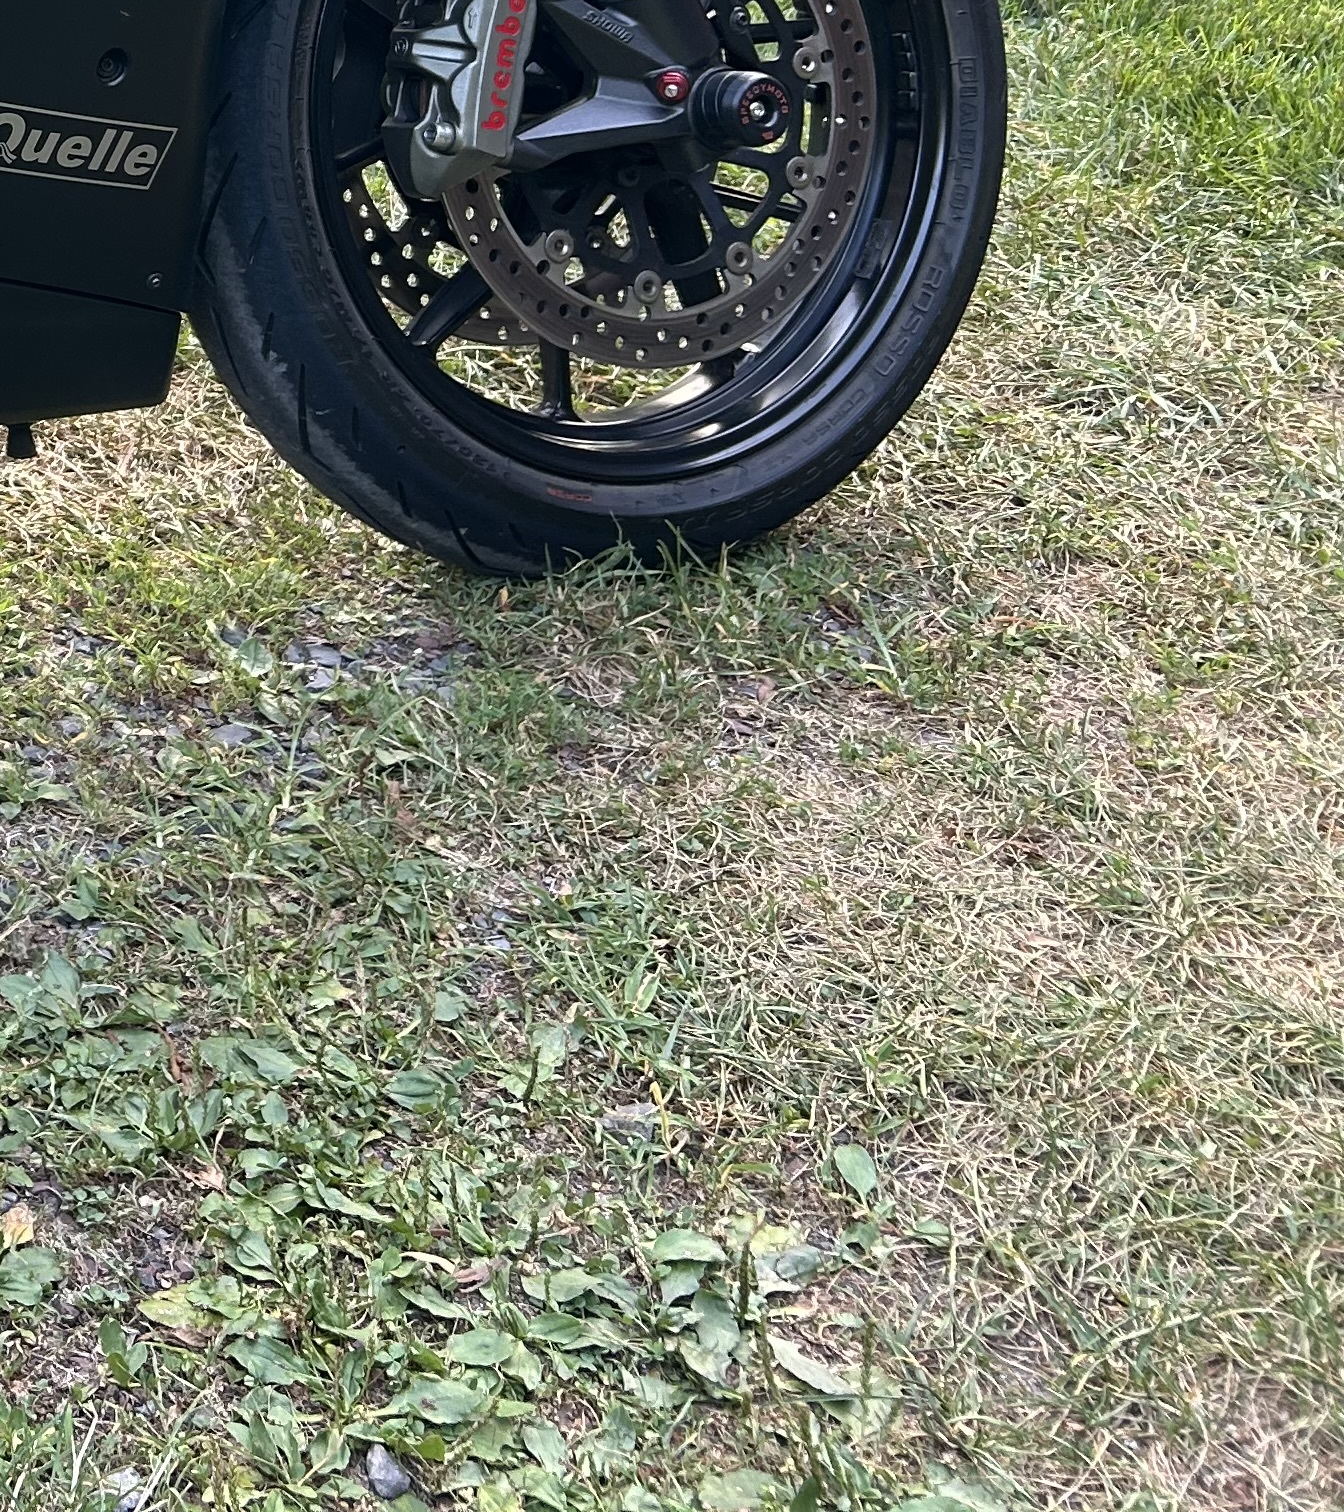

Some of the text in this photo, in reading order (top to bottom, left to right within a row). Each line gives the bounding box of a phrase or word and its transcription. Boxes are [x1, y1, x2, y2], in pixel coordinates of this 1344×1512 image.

[582, 9, 635, 45] SHOWA
[949, 56, 980, 213] DIABLO
[875, 262, 949, 378] ROSSO
